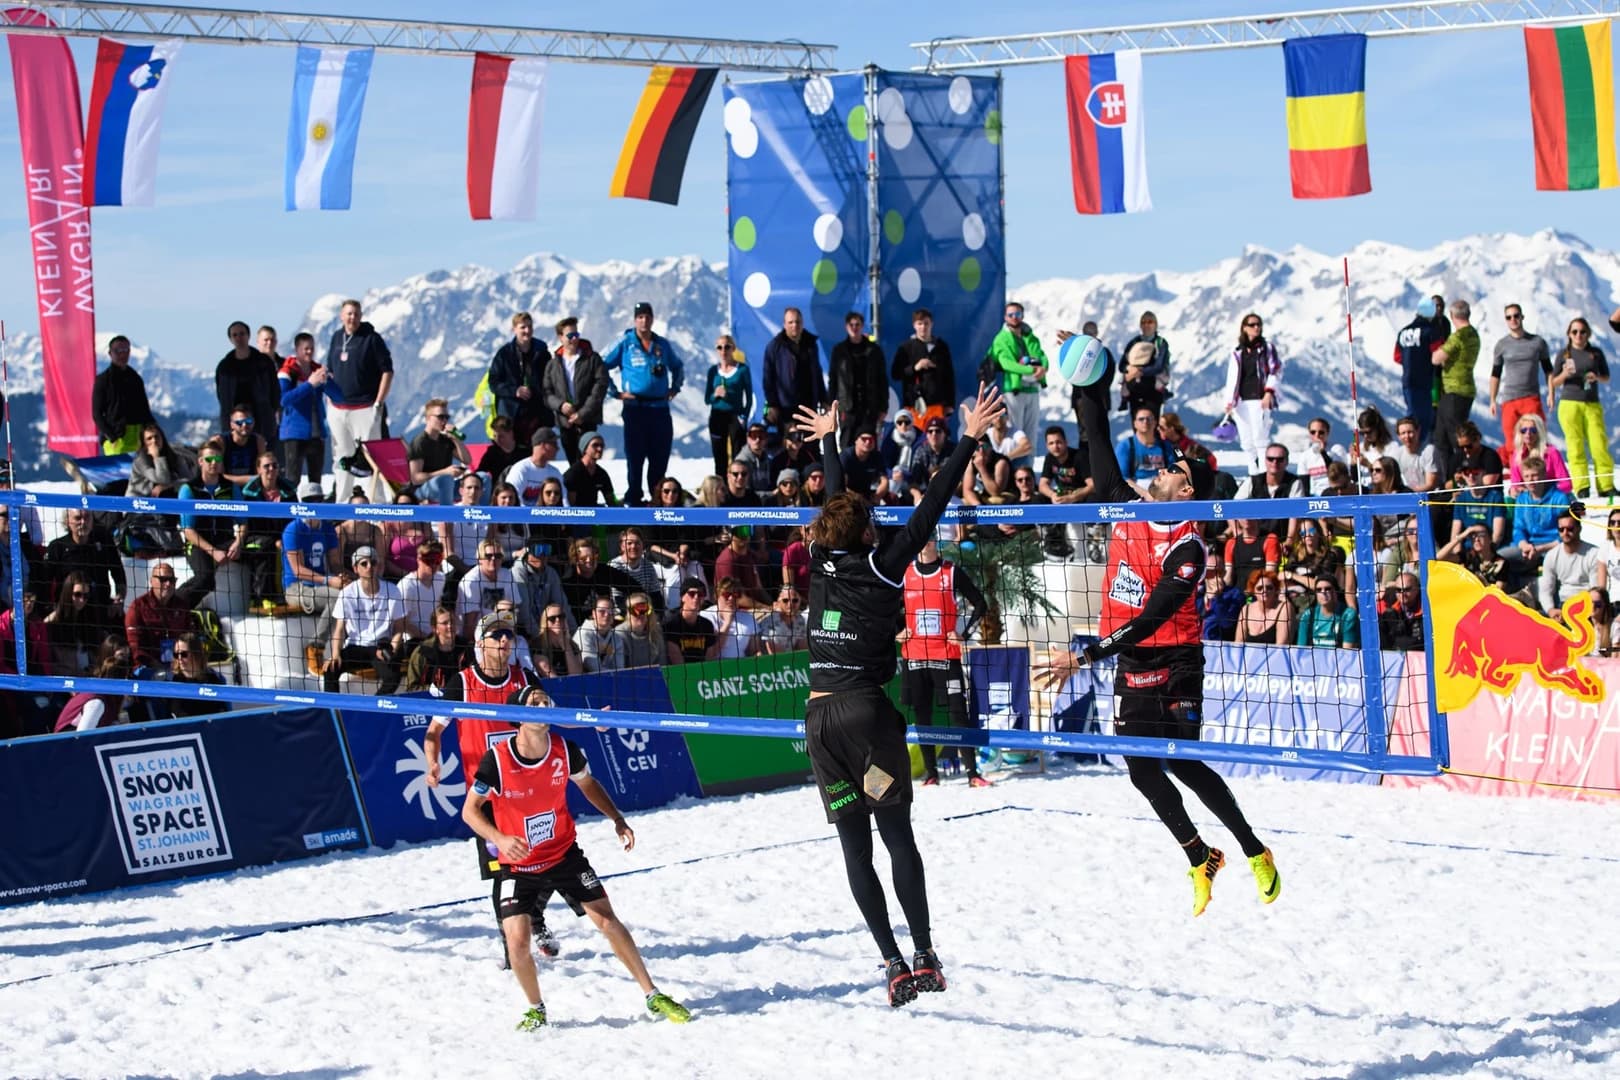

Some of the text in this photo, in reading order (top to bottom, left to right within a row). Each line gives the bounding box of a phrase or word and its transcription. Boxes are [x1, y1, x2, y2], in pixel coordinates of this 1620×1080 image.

[697, 665, 810, 700] GANZ SCHÖN
[1203, 671, 1360, 700] owVolleyball on
[402, 713, 428, 727] FIVB
[1485, 732, 1585, 765] KLEIN
[117, 755, 192, 776] FLACHAU
[552, 758, 564, 777] 2
[627, 754, 658, 772] CEV
[122, 769, 194, 798] SNOW
[551, 777, 565, 786] AUT
[128, 792, 201, 812] WAGRAIN
[132, 806, 207, 836] SPACE
[529, 819, 553, 831] SNOW
[137, 830, 211, 851] ST. JOHANN
[142, 847, 216, 868] SALZBURG
